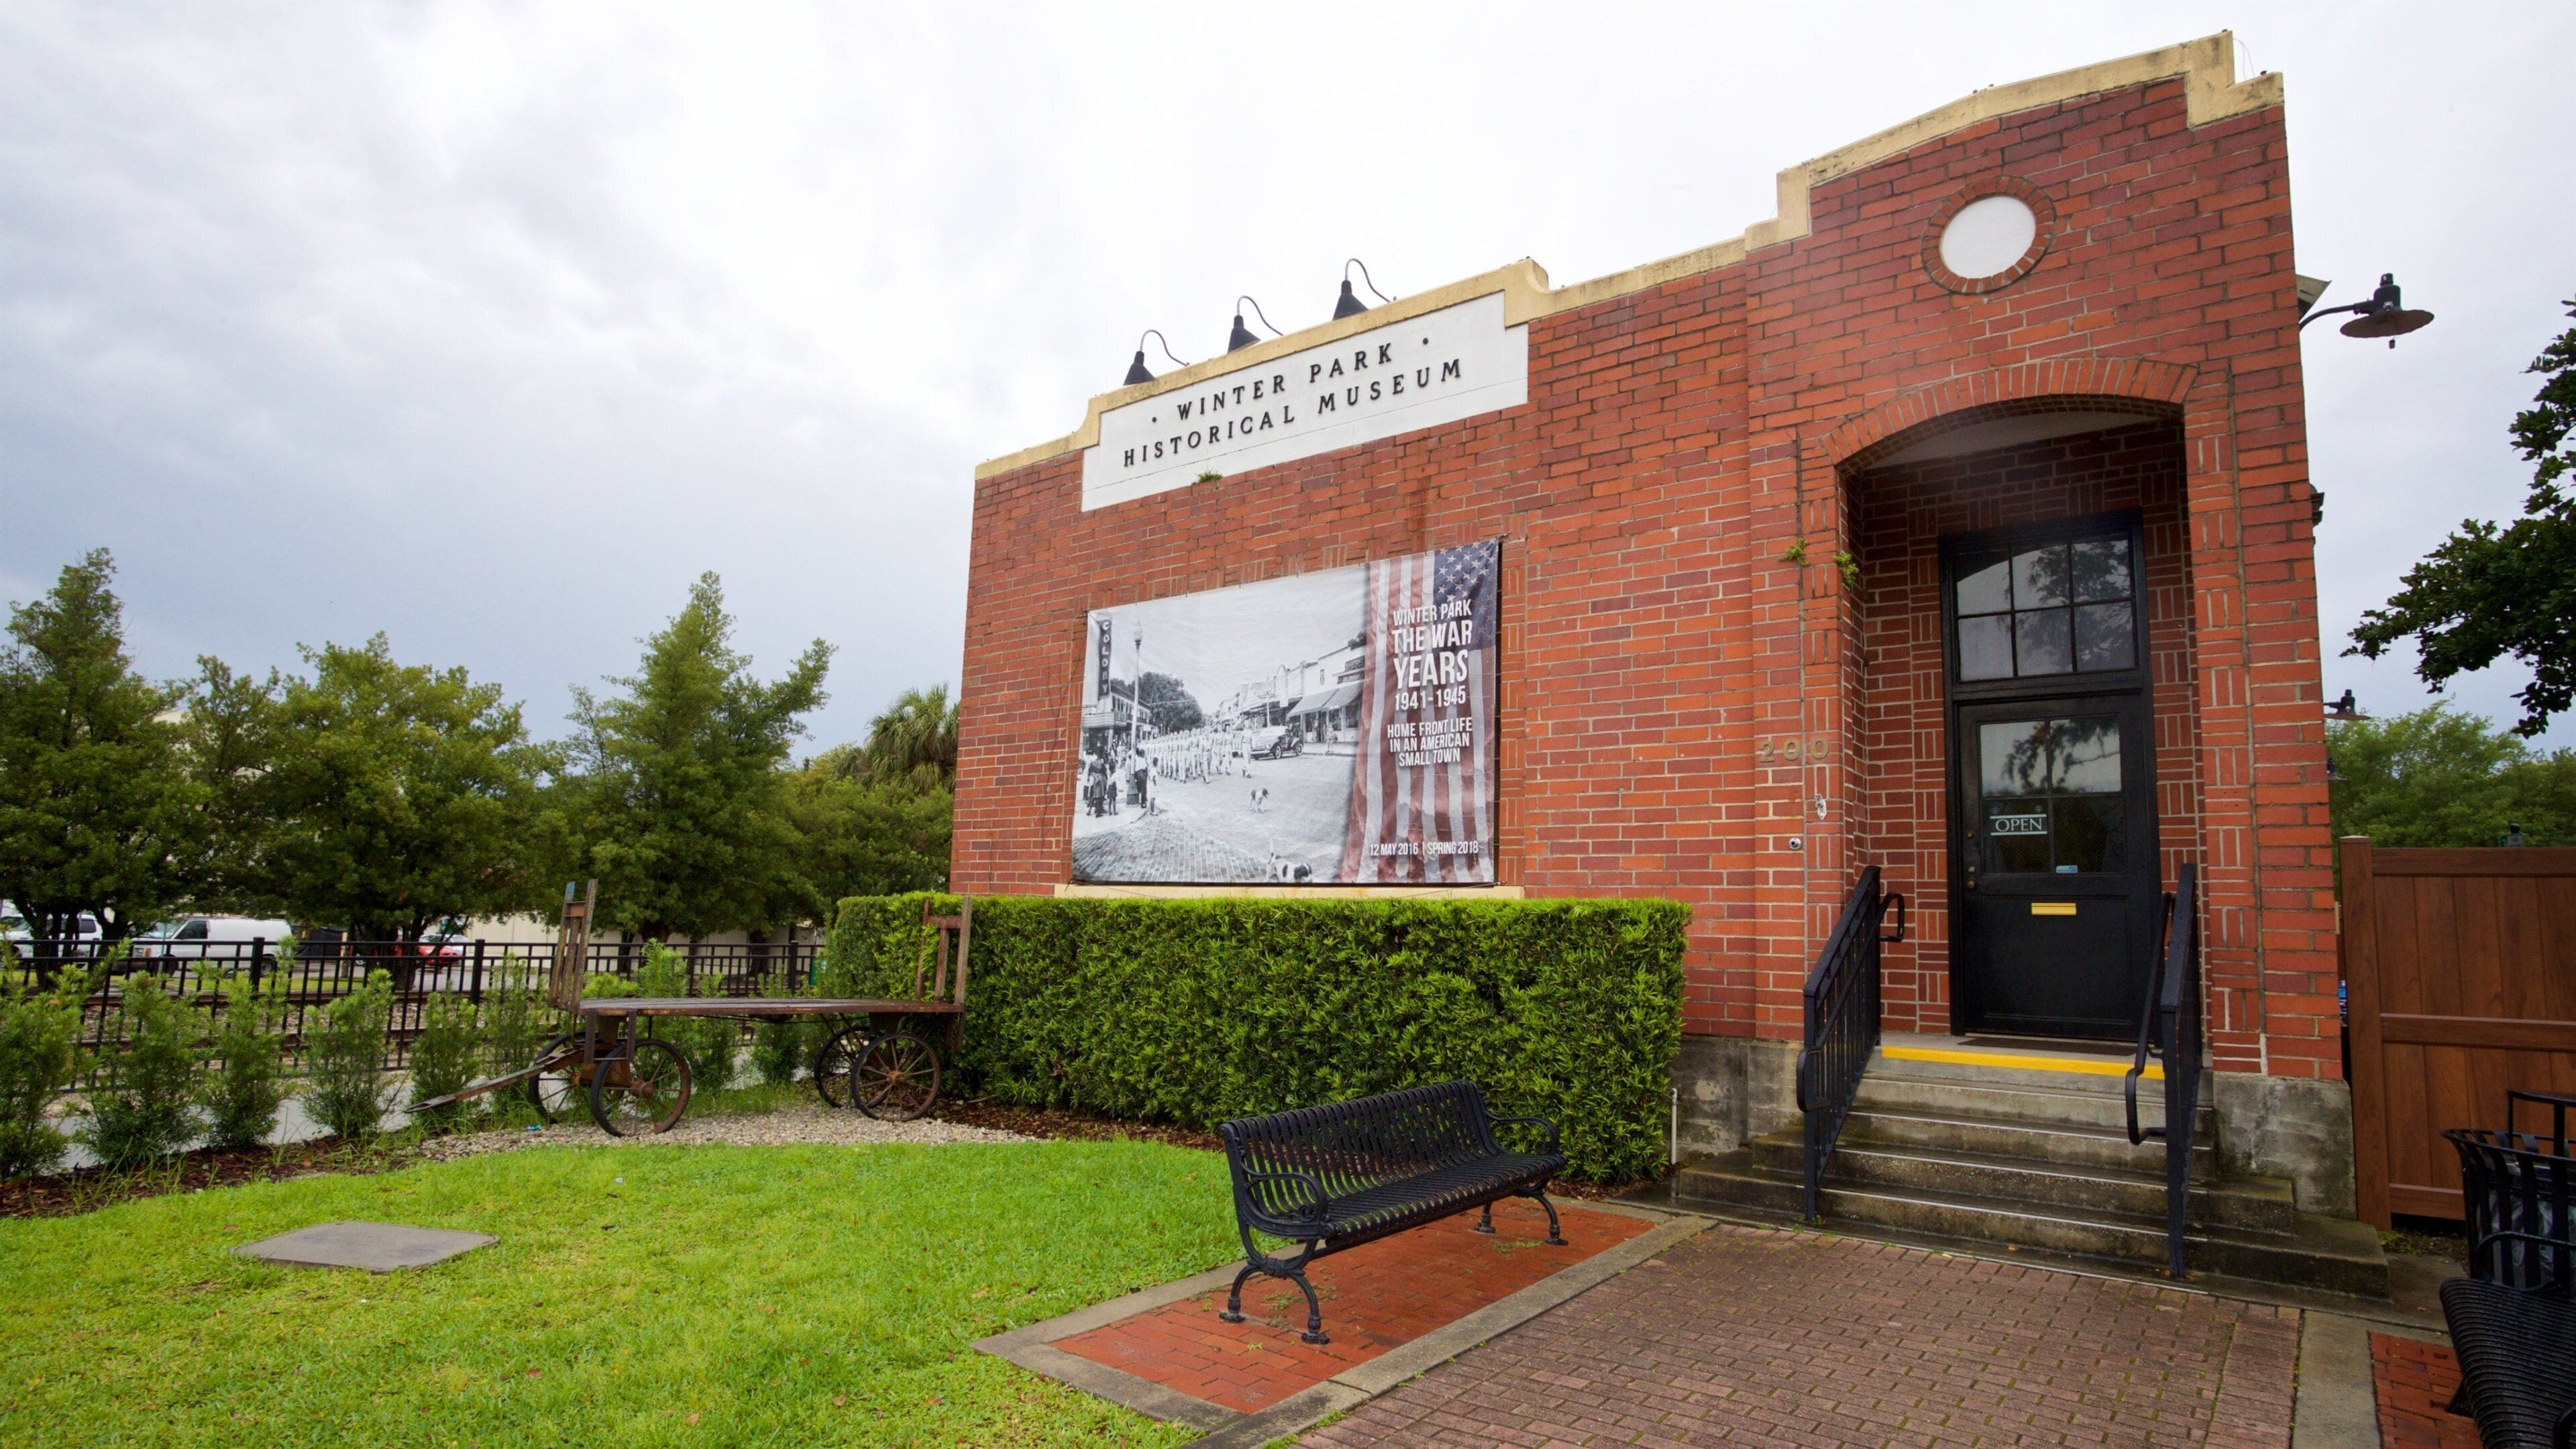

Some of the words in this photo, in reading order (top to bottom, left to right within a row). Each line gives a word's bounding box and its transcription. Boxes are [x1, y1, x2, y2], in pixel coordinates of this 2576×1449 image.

[1177, 374, 1286, 421] WINTER
[1309, 342, 1393, 383] PARK
[1123, 405, 1295, 468] HISTORICAL
[1317, 358, 1461, 415] MUSEUM
[1393, 605, 1437, 626] WINTER
[1441, 599, 1471, 619] PARK
[1392, 626, 1426, 654] THE
[1432, 620, 1473, 648] WAR
[1393, 649, 1468, 689] YEARS
[1387, 722, 1416, 738] HOME
[1419, 720, 1448, 736] FRONT
[1450, 717, 1472, 732] LIFE
[1390, 739, 1400, 752] IN
[1403, 737, 1417, 751] AN
[1420, 733, 1470, 751] AMERICAN
[1758, 737, 1830, 763] 200
[1399, 751, 1430, 766] SMALL
[1433, 748, 1460, 763] TOWN
[1995, 818, 2042, 832] OPEN
[1370, 844, 1379, 856] 12
[1381, 843, 1397, 856] MAY
[1398, 843, 1418, 855] 2016
[1427, 841, 1456, 855] SPRING
[1458, 841, 1479, 854] 2018
